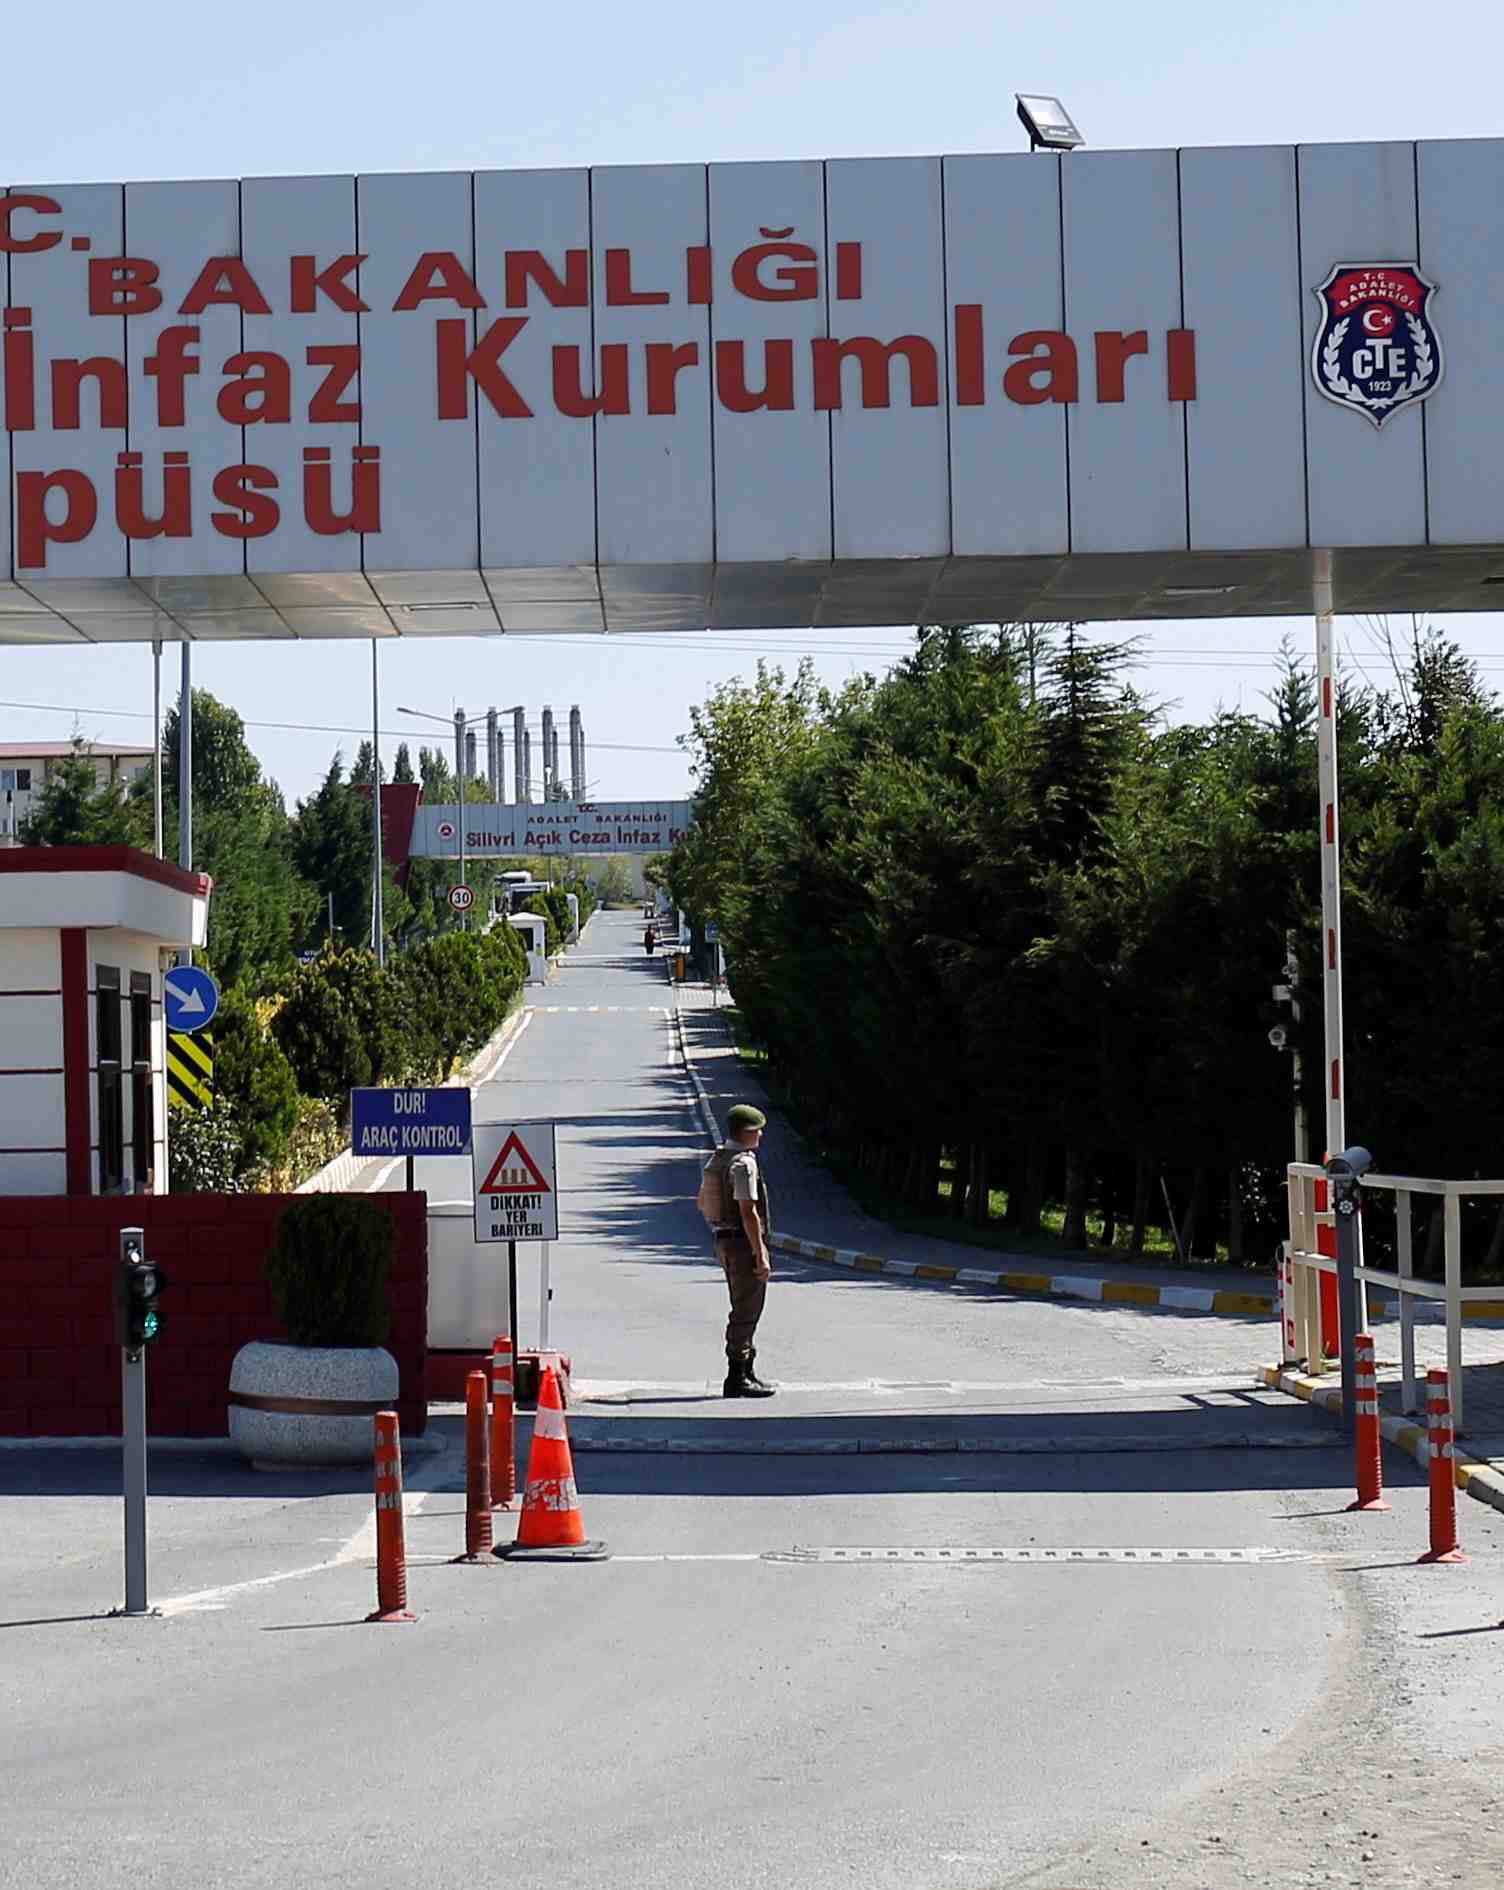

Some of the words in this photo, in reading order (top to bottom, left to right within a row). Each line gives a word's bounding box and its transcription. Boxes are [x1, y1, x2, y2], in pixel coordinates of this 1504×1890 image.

[88, 227, 862, 316] BAKANLIĞI
[3, 306, 362, 433] İnfaz
[436, 303, 1197, 421] Kurumları
[1352, 338, 1407, 379] CTE
[1368, 380, 1392, 392] 1923
[466, 831, 516, 848] Silivri
[524, 832, 561, 849] Açık
[569, 830, 611, 844] Ceza
[616, 825, 661, 844] İnfaz
[452, 891, 470, 904] 30
[393, 1092, 426, 1115] DUR!
[361, 1126, 398, 1154] ARAÇ
[401, 1124, 463, 1148] KONTROL
[506, 1210, 528, 1224] YER
